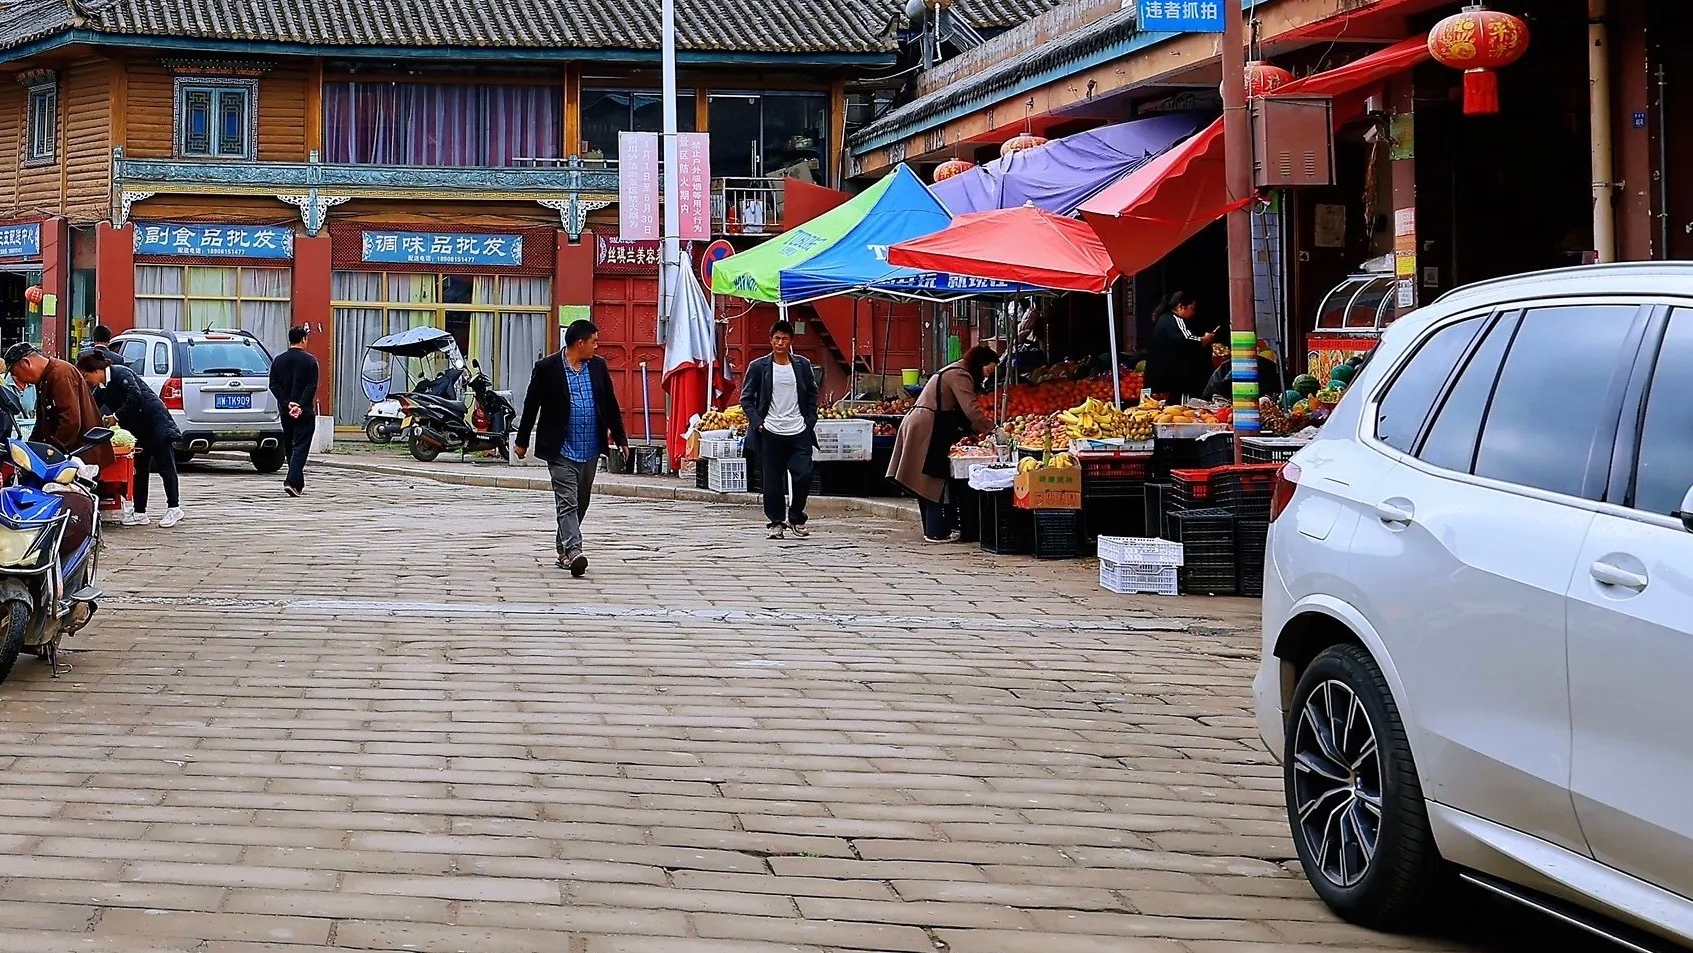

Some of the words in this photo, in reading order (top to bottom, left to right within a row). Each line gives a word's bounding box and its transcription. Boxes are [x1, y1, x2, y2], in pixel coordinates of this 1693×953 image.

[1145, 1, 1218, 20] 违者抓拍
[679, 136, 690, 214] 景区防火期内
[691, 142, 703, 233] 禁止户外吸烟等用火行为
[144, 226, 277, 249] 副食品批发
[375, 235, 507, 257] 调味品批发
